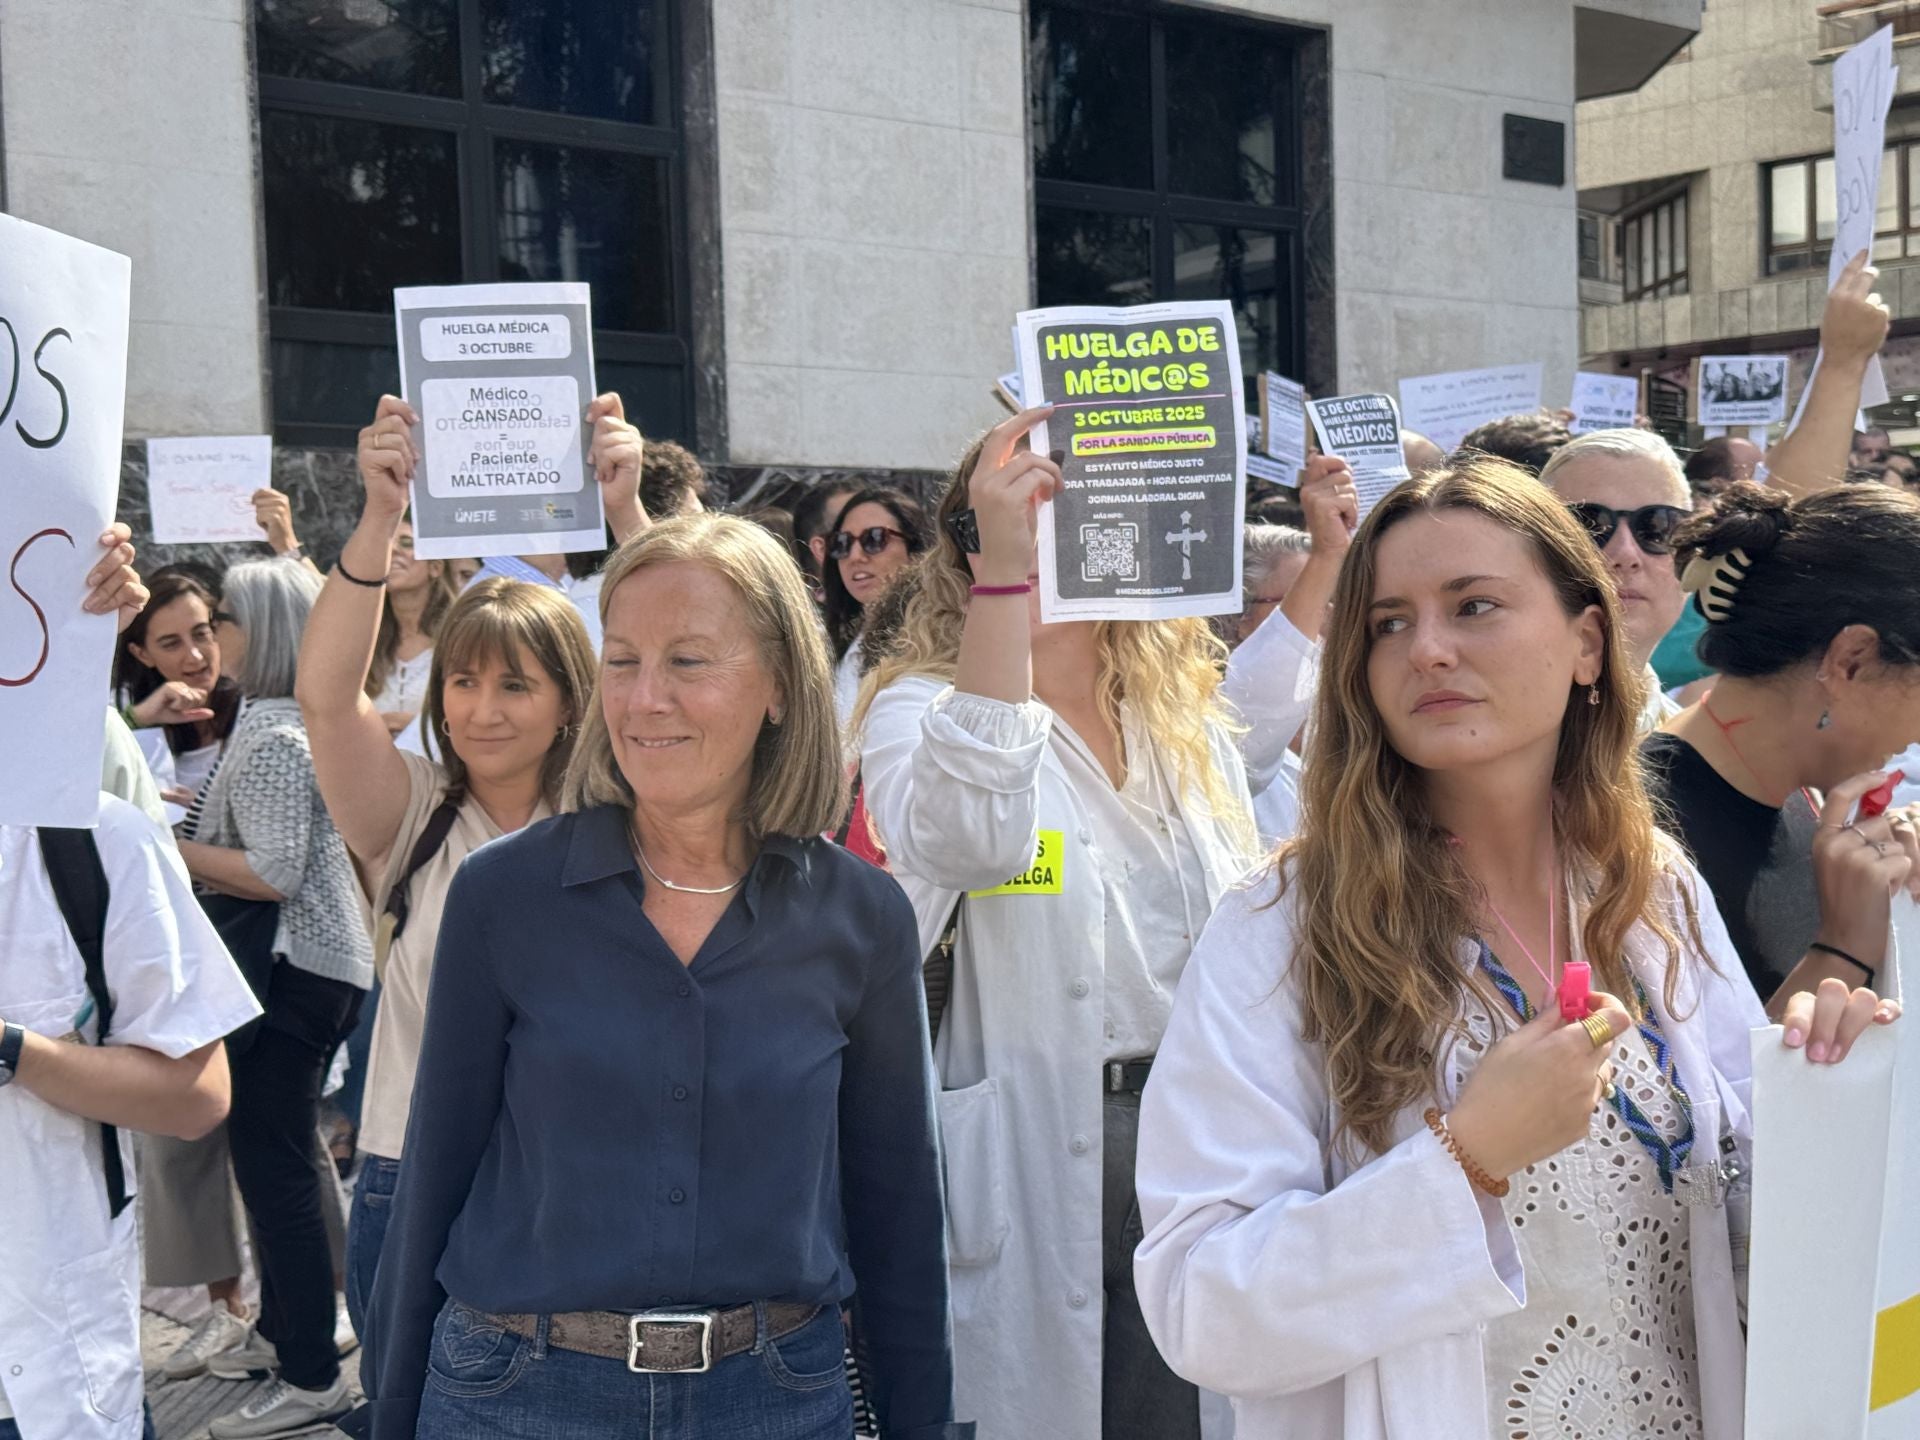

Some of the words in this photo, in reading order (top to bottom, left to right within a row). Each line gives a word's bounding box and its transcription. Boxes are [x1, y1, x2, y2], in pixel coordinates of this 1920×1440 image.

[442, 323, 495, 335] HUELGA
[499, 320, 549, 334] MÉDICA
[459, 344, 467, 355] 3
[470, 342, 533, 354] OCTUBRE
[1045, 330, 1173, 360] HUELGA
[1176, 326, 1220, 353] DE
[1065, 360, 1210, 396] MÉDIC@S
[470, 387, 528, 401] Médico
[1318, 406, 1328, 416] 3
[1328, 403, 1344, 415] DE
[1344, 398, 1389, 412] OCTUBRE
[462, 408, 543, 423] CANSADO
[1074, 412, 1086, 427] 3
[1088, 408, 1163, 426] OCTUBRE
[1165, 406, 1205, 421] 2025
[1324, 415, 1352, 426] HUELGA
[1352, 411, 1384, 423] NACIONAL
[1077, 440, 1100, 450] POR
[1101, 438, 1117, 448] LA
[1118, 435, 1166, 447] SANIDAD
[1167, 432, 1211, 445] PÚBLICA
[1328, 423, 1395, 446] MÉDICOS
[470, 452, 539, 466] Paciente
[1085, 461, 1138, 472] ESTATUTO
[1140, 458, 1173, 469] MÉDICO
[1174, 458, 1204, 468] JUSTO
[451, 471, 561, 487] MALTRATADO
[1064, 480, 1084, 489] ORA
[1085, 477, 1145, 488] TRABAJADA
[1152, 476, 1177, 486] HORA
[1178, 473, 1232, 484] COMPUTADA
[1088, 494, 1134, 504] JORNADA
[1135, 492, 1177, 503] LABORAL
[1178, 491, 1205, 501] DIGNA
[1004, 867, 1054, 885] ELGA
